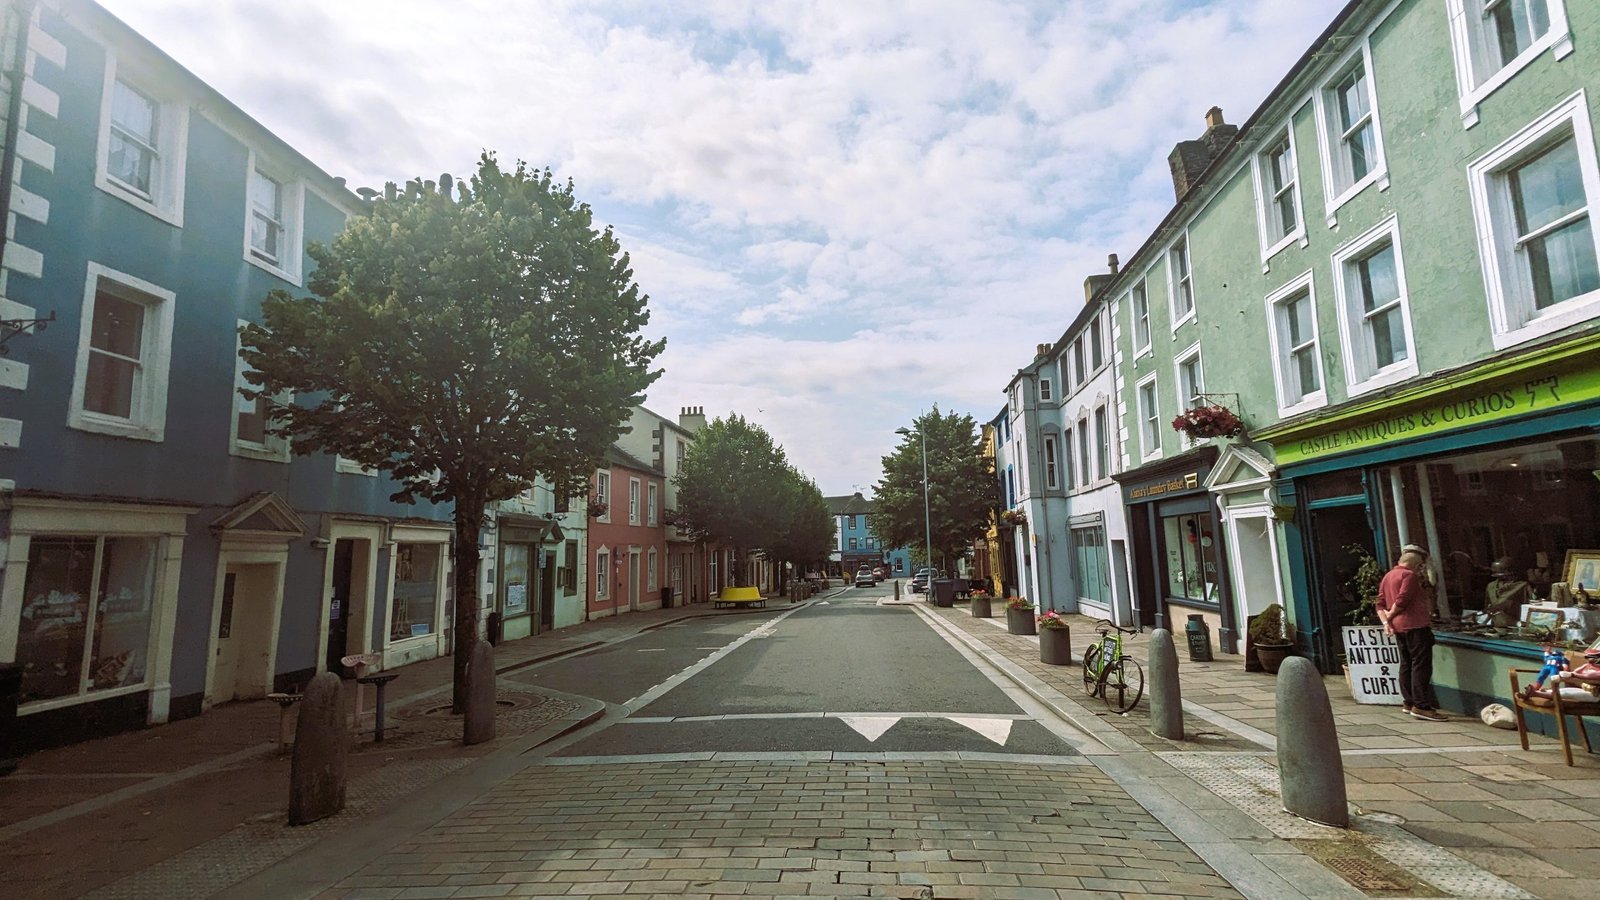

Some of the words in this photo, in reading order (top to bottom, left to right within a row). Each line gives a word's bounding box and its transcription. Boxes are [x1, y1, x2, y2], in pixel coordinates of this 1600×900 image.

[1300, 432, 1342, 456] CASTLE
[1345, 414, 1416, 445] ANTIQUES
[1421, 409, 1437, 428] &
[1441, 388, 1516, 423] CURIOS
[1166, 478, 1185, 492] Basket
[1348, 629, 1397, 646] CASTL
[1349, 647, 1400, 664] ANTIQU
[1380, 665, 1391, 676] &
[1361, 677, 1400, 696] CURI
